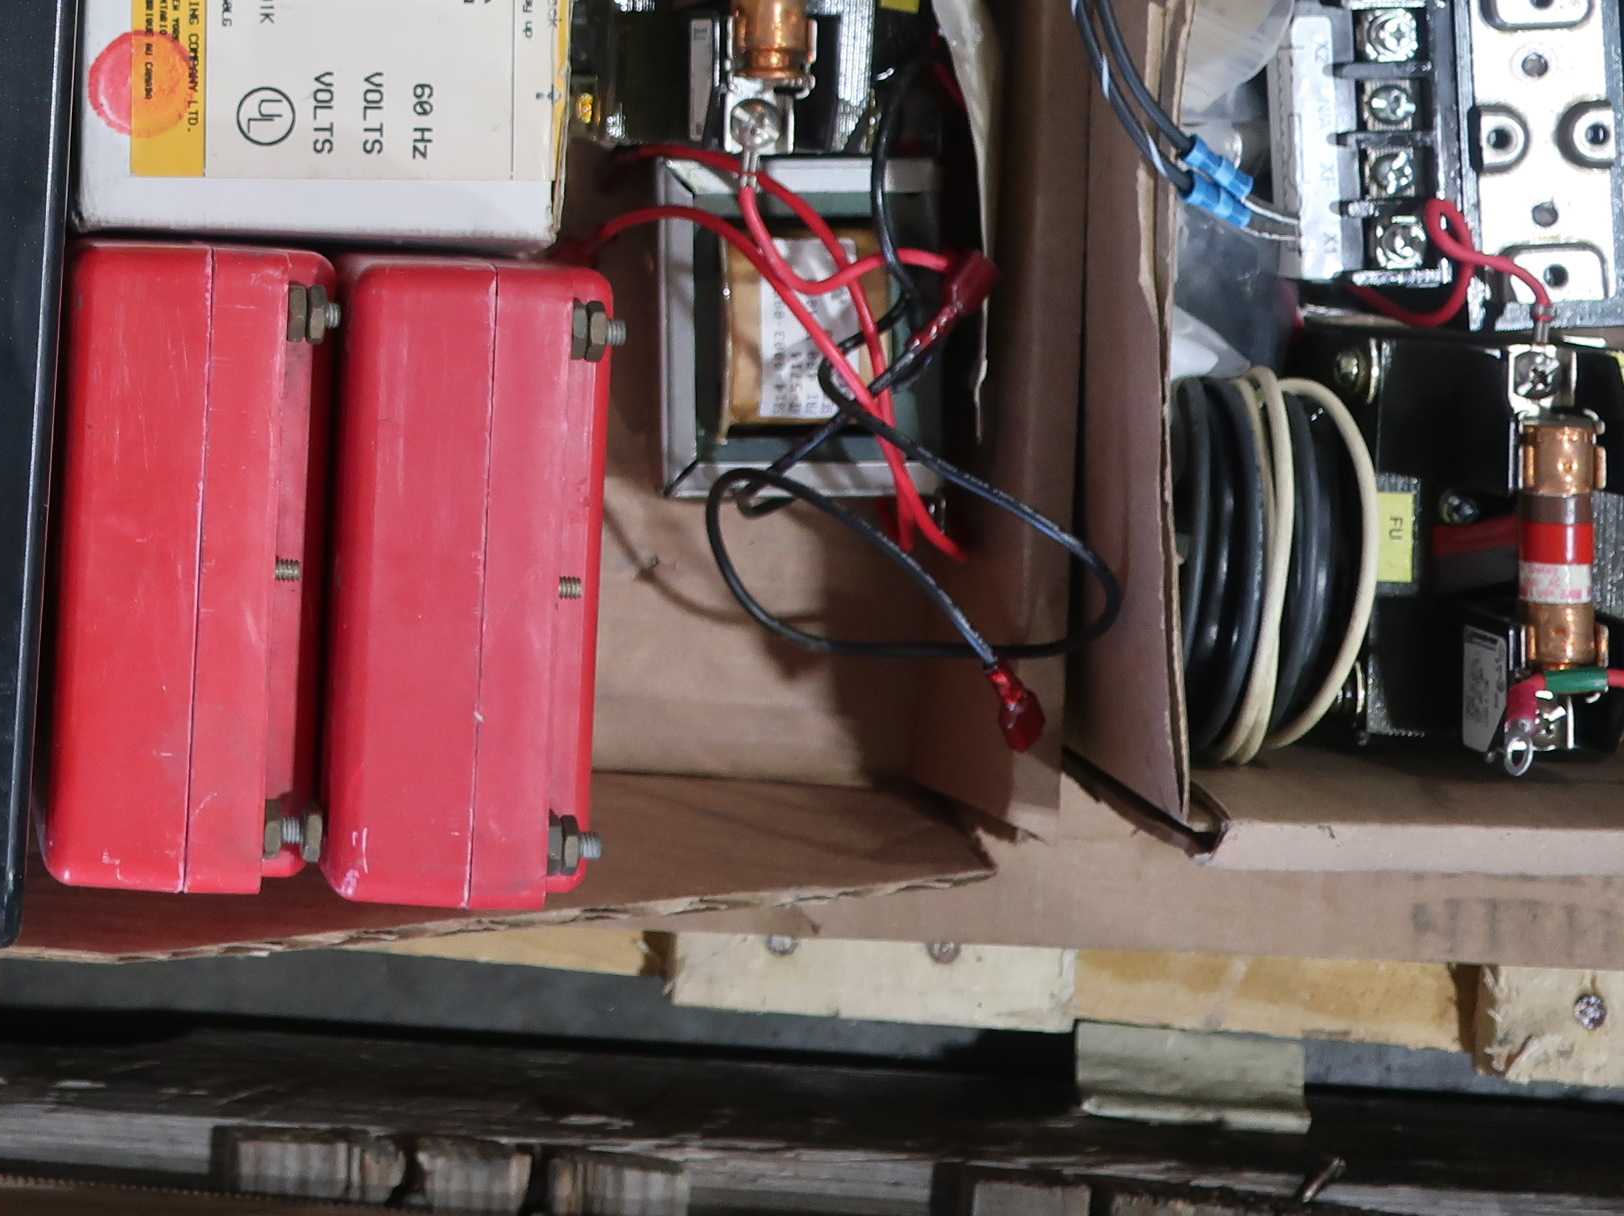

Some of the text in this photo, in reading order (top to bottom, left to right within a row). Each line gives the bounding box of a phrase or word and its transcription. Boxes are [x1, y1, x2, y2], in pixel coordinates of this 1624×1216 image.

[522, 20, 534, 40] up
[145, 43, 152, 56] AU
[188, 34, 199, 93] COMPANY
[144, 62, 152, 100] CANADA
[313, 72, 335, 155] VOLTS
[362, 72, 384, 156] VOLTS
[413, 83, 433, 116] 60
[187, 100, 197, 133] LTD.
[411, 128, 431, 161] Hz
[1387, 517, 1404, 541] FU
